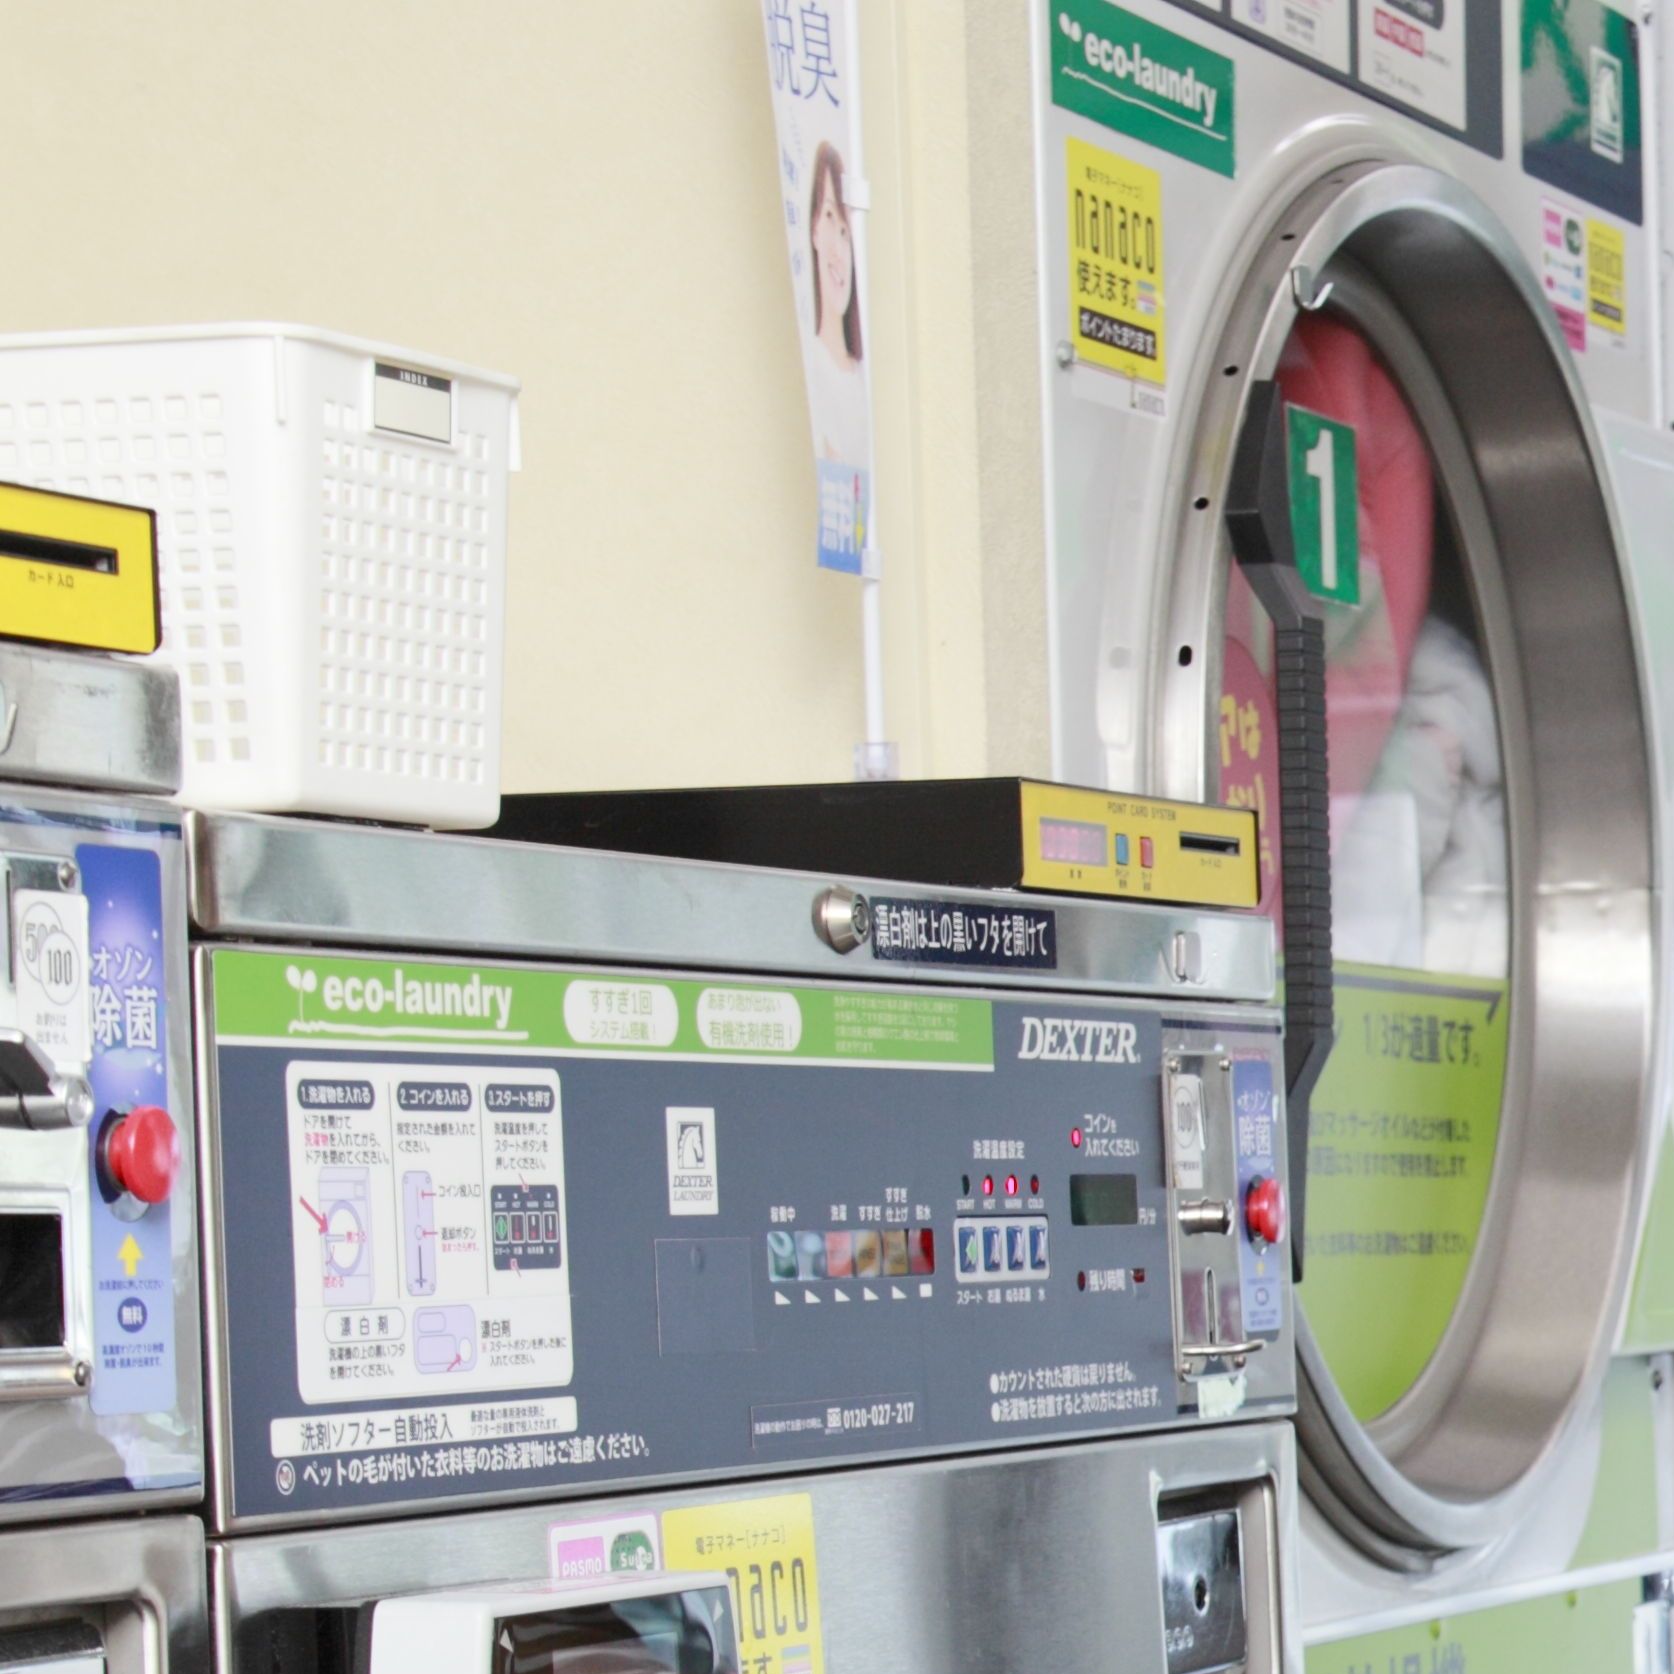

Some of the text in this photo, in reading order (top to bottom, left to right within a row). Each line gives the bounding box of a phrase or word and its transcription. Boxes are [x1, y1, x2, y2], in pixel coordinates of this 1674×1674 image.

[1083, 33, 1217, 127] eco-laundry
[1075, 188, 1156, 275] nanaco
[1306, 428, 1337, 590] 1
[28, 568, 74, 589] カード入口
[48, 949, 73, 986] 100
[92, 946, 153, 982] オゾン
[90, 984, 158, 1050] 除菌
[323, 968, 512, 1030] eco-laundry
[1018, 1016, 1138, 1064] DEXTER
[1084, 1113, 1117, 1134] コインを
[1085, 1137, 1140, 1158] 入れてください
[673, 1175, 713, 1188] DEXTER
[957, 1289, 984, 1304] スタート
[300, 1412, 454, 1451] 洗剤ソフター自動投入
[843, 1401, 915, 1430] 0120-027-217
[562, 1556, 602, 1577] PASMO
